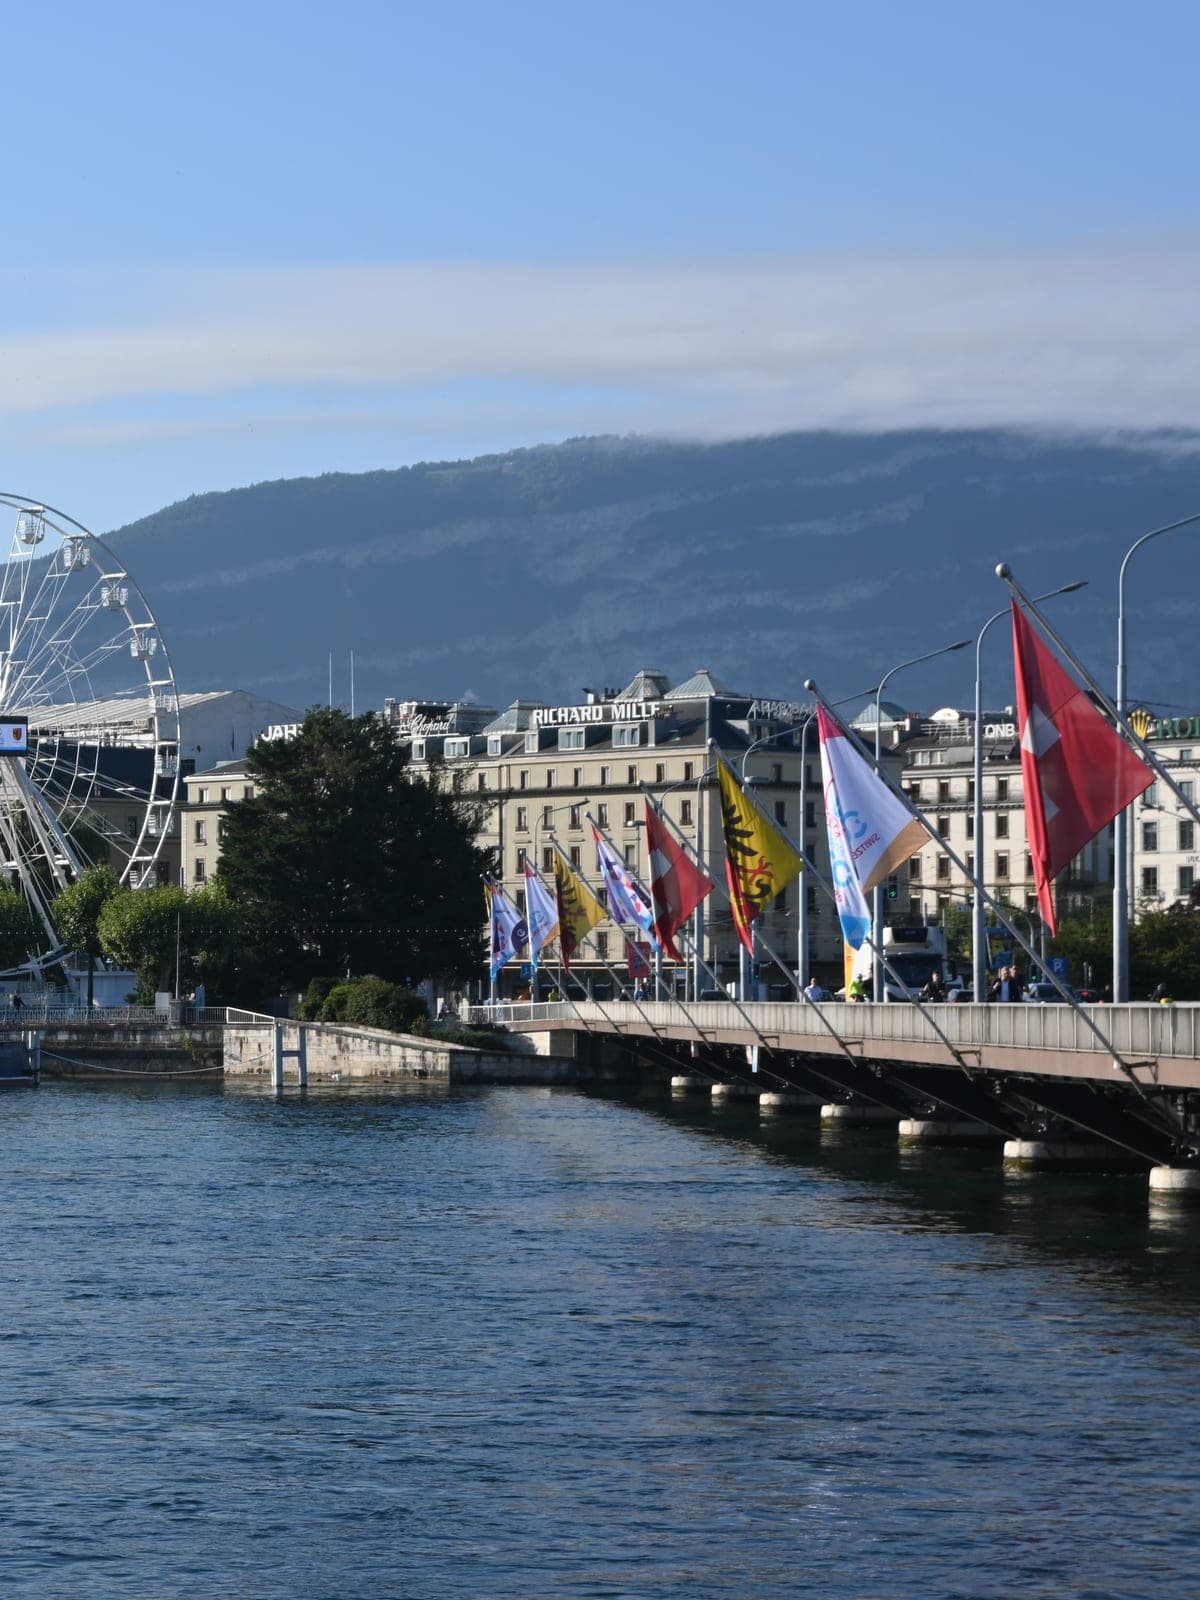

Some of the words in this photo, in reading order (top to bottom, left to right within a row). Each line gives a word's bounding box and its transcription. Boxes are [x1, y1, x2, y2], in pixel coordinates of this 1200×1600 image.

[410, 713, 452, 735] Chopard
[532, 706, 603, 724] RICHARD
[611, 702, 660, 720] MILLE
[985, 723, 1015, 738] QNB
